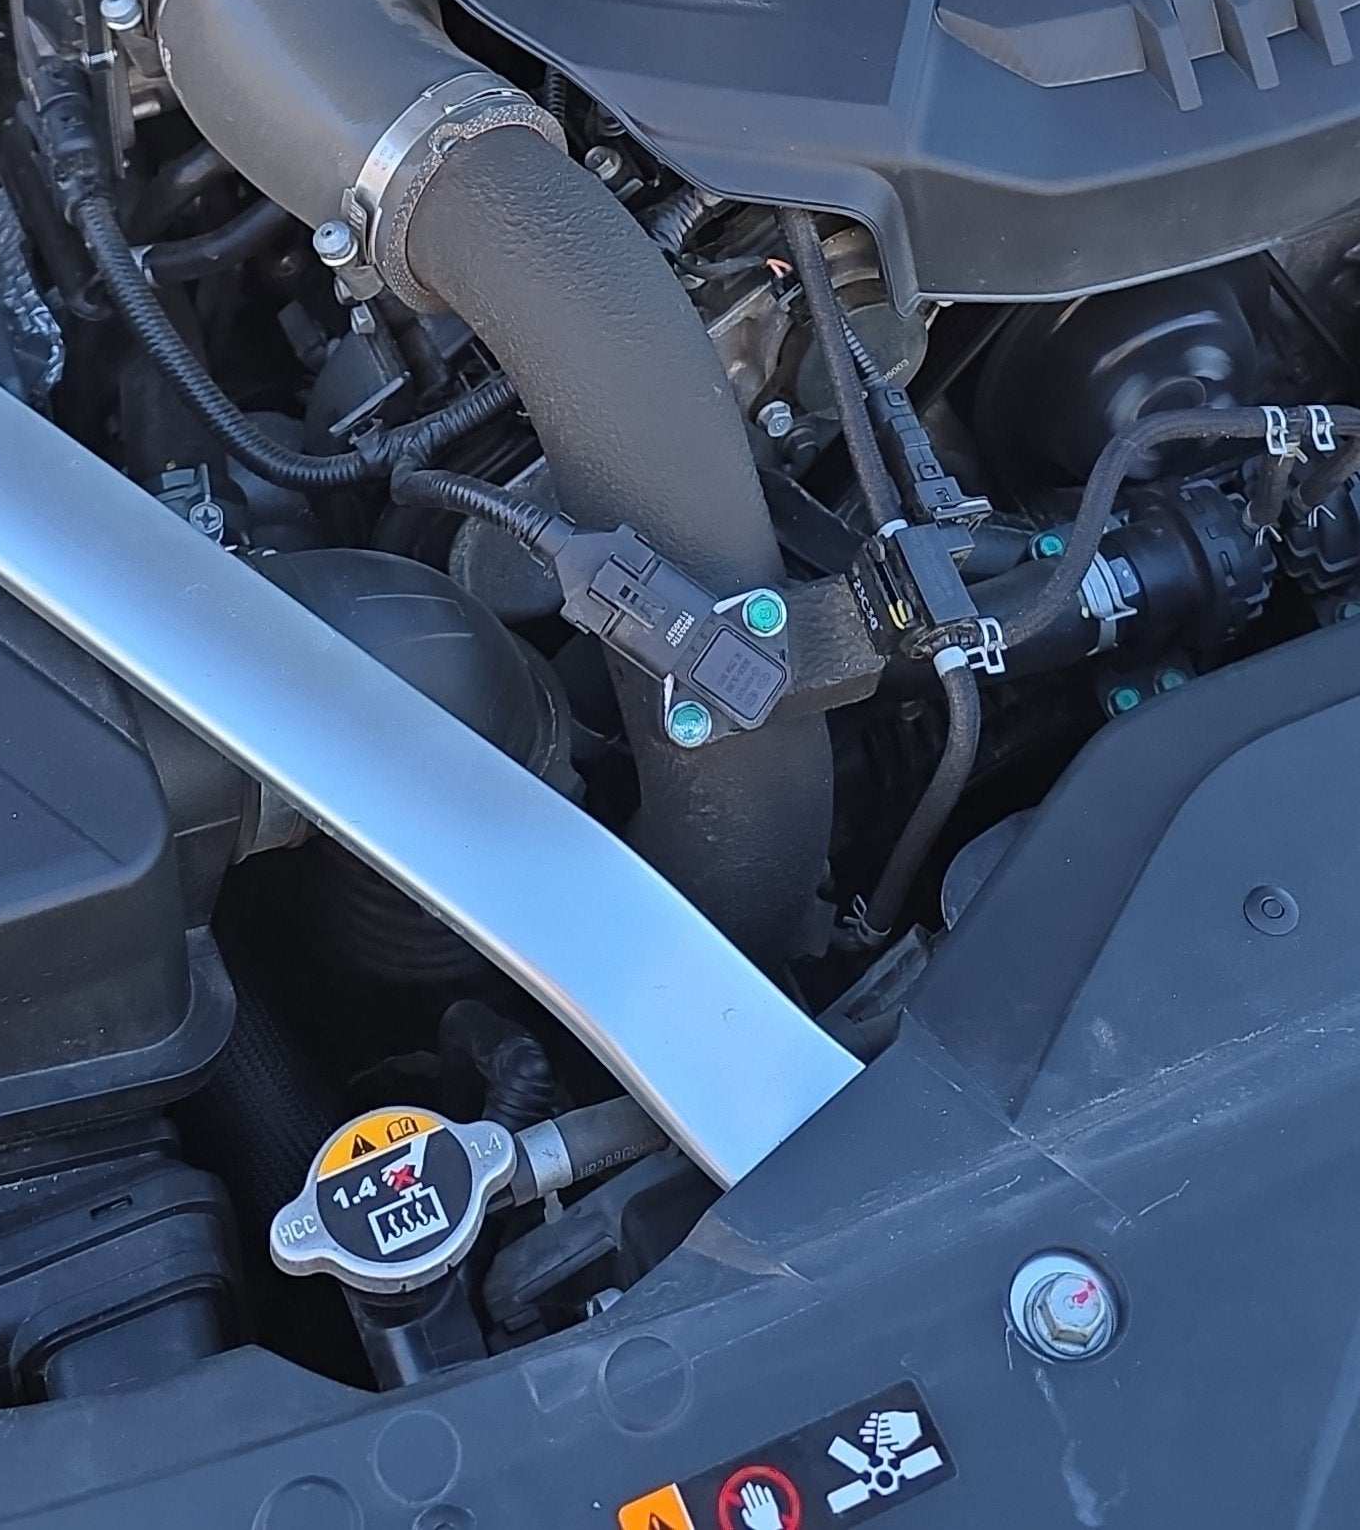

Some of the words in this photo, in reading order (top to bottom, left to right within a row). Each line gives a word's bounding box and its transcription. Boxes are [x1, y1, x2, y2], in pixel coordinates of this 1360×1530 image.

[469, 1132, 503, 1160] 1.4
[332, 1175, 378, 1210] 1.4
[278, 1213, 319, 1246] HCC
